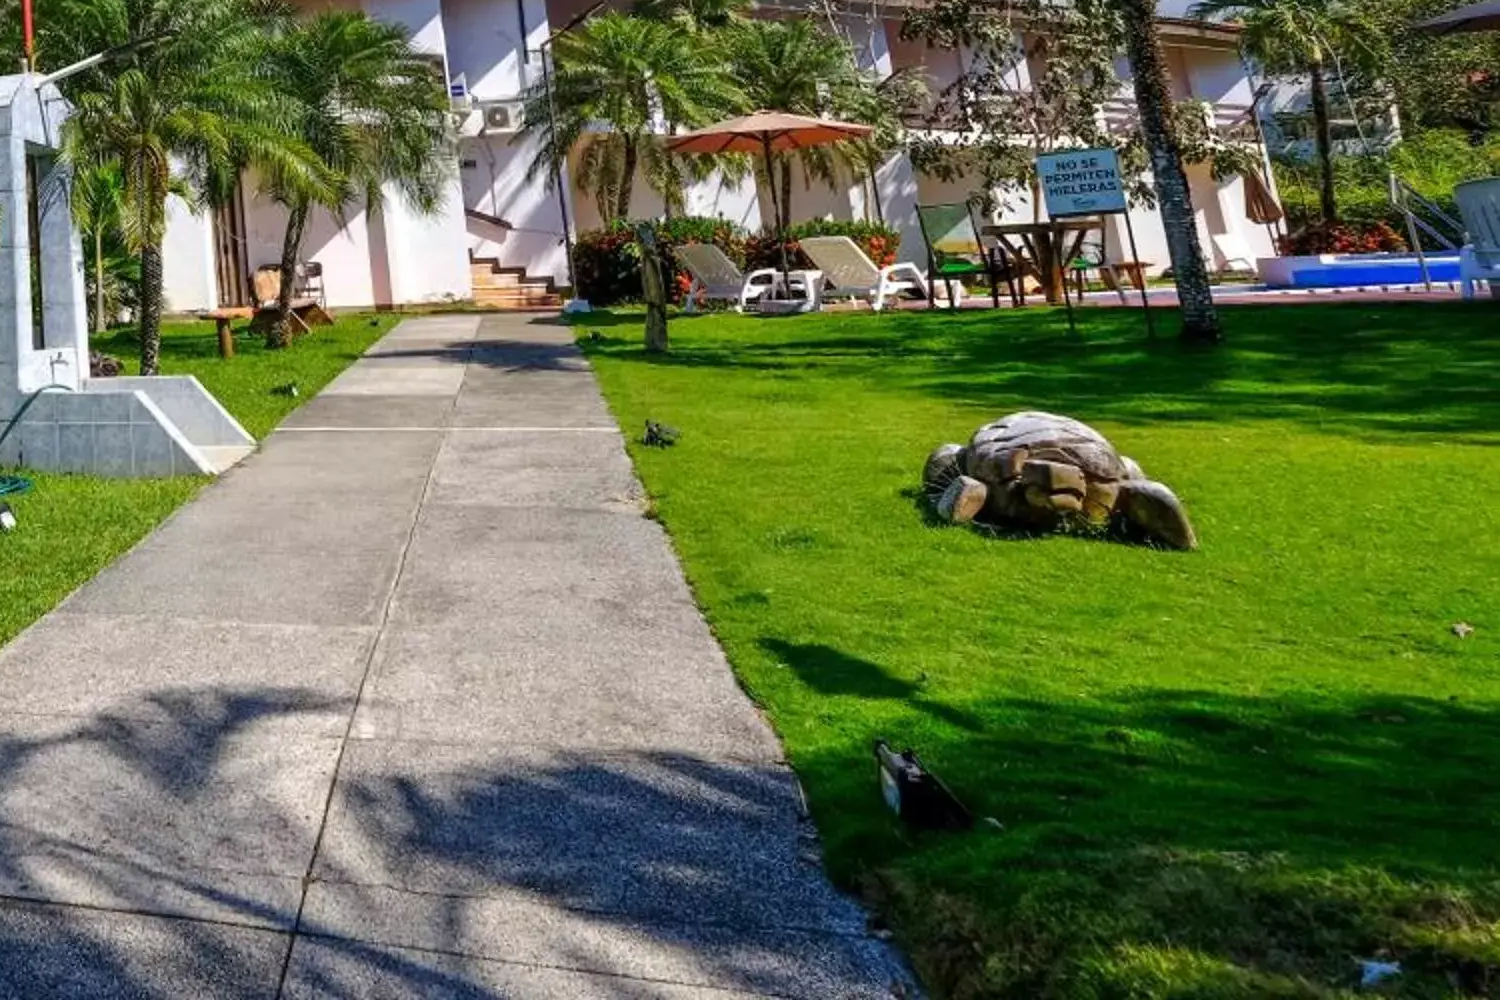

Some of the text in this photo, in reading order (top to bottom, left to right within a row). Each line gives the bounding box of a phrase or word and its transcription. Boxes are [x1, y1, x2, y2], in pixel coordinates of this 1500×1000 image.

[1056, 157, 1098, 171] NO SE
[1045, 169, 1115, 184] PERMITEN
[1049, 181, 1117, 196] HIELERAS
